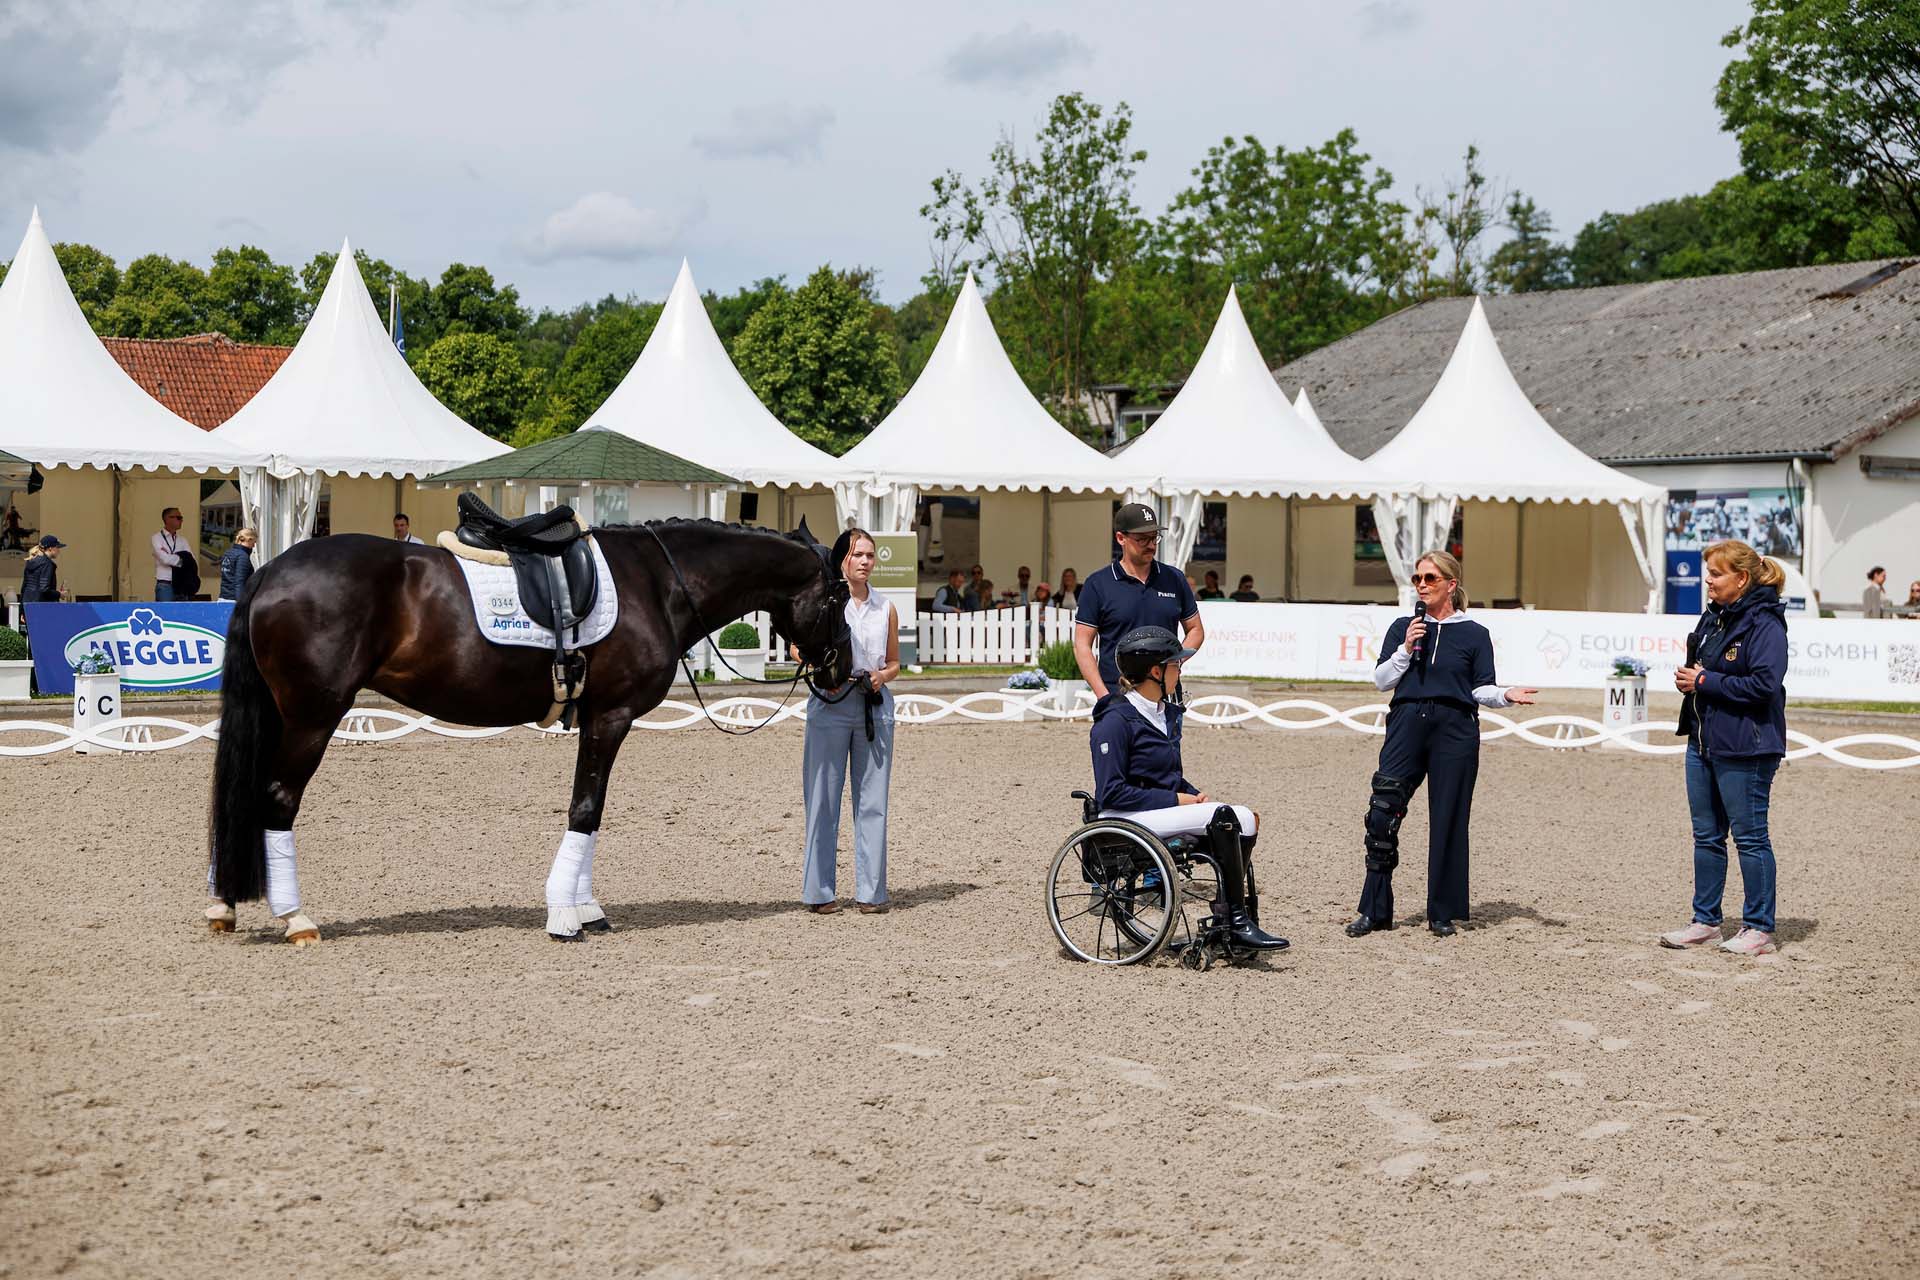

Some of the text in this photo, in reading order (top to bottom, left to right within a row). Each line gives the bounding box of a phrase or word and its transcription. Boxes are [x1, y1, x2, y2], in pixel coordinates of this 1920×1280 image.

[492, 598, 513, 608] 0344
[493, 617, 522, 630] Agria
[1207, 629, 1297, 643] ANSEKLINIK
[90, 640, 213, 666] MEGGLE
[1807, 642, 1878, 661] GMBH
[78, 696, 86, 716] C
[97, 695, 114, 716] C
[1610, 688, 1625, 706] M
[1634, 688, 1644, 706] M
[1613, 711, 1621, 721] G
